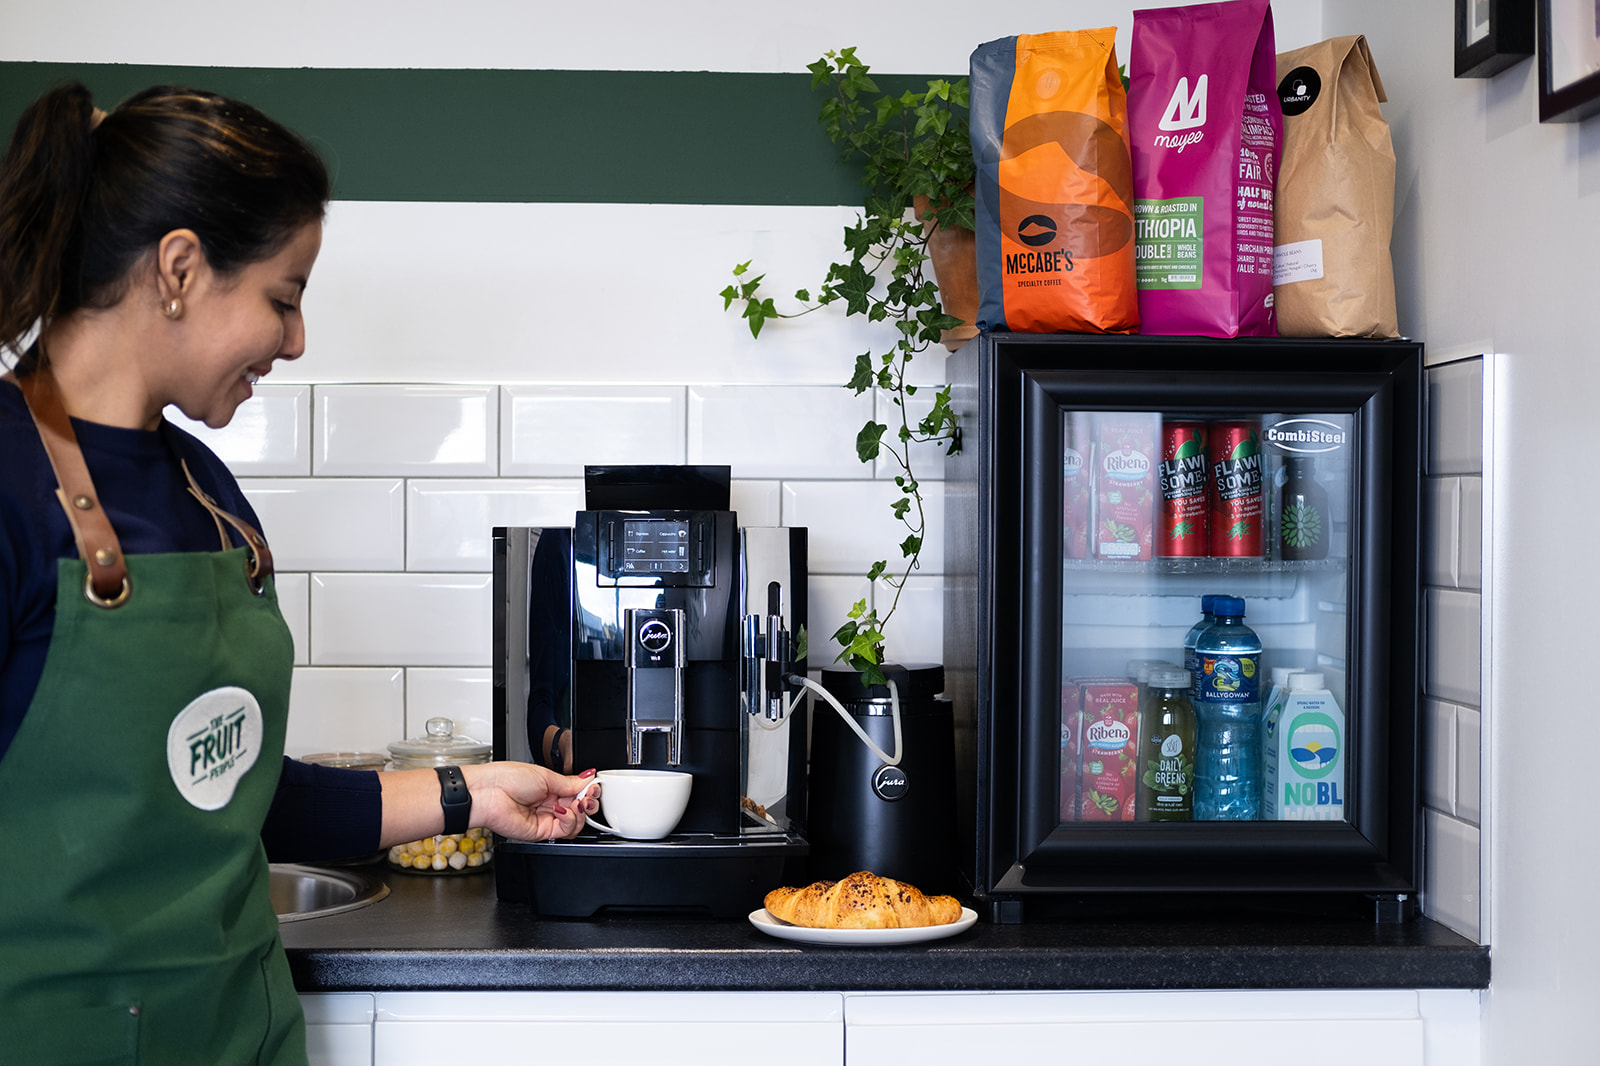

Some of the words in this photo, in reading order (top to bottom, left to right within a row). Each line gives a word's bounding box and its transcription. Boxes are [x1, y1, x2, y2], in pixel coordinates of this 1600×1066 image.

[1154, 131, 1204, 153] moyee
[1239, 163, 1261, 180] FAIR
[1238, 186, 1260, 198] HALF
[1154, 205, 1160, 214] &
[1160, 203, 1188, 213] ROASTED
[1189, 203, 1198, 212] IN
[1247, 200, 1269, 210] normal
[1135, 218, 1197, 238] THIOPIA
[1136, 244, 1166, 259] OUBLE
[1017, 280, 1042, 288] SPECIALTY
[1268, 428, 1346, 444] CombiSteel
[1107, 456, 1149, 471] Ribena
[1158, 454, 1201, 477] FLAW
[1214, 454, 1258, 477] FLAW
[1161, 470, 1203, 491] SOME
[1217, 470, 1260, 491] SOME
[641, 630, 669, 643] jura
[1206, 691, 1249, 699] BALLYGOWAN
[1090, 726, 1129, 740] Ribena
[190, 714, 246, 776] FRUIT
[210, 755, 235, 780] PEOPLE
[1160, 757, 1182, 771] DAILY
[878, 777, 905, 790] jura
[1155, 772, 1186, 787] GREENS
[1284, 781, 1343, 806] NOBL
